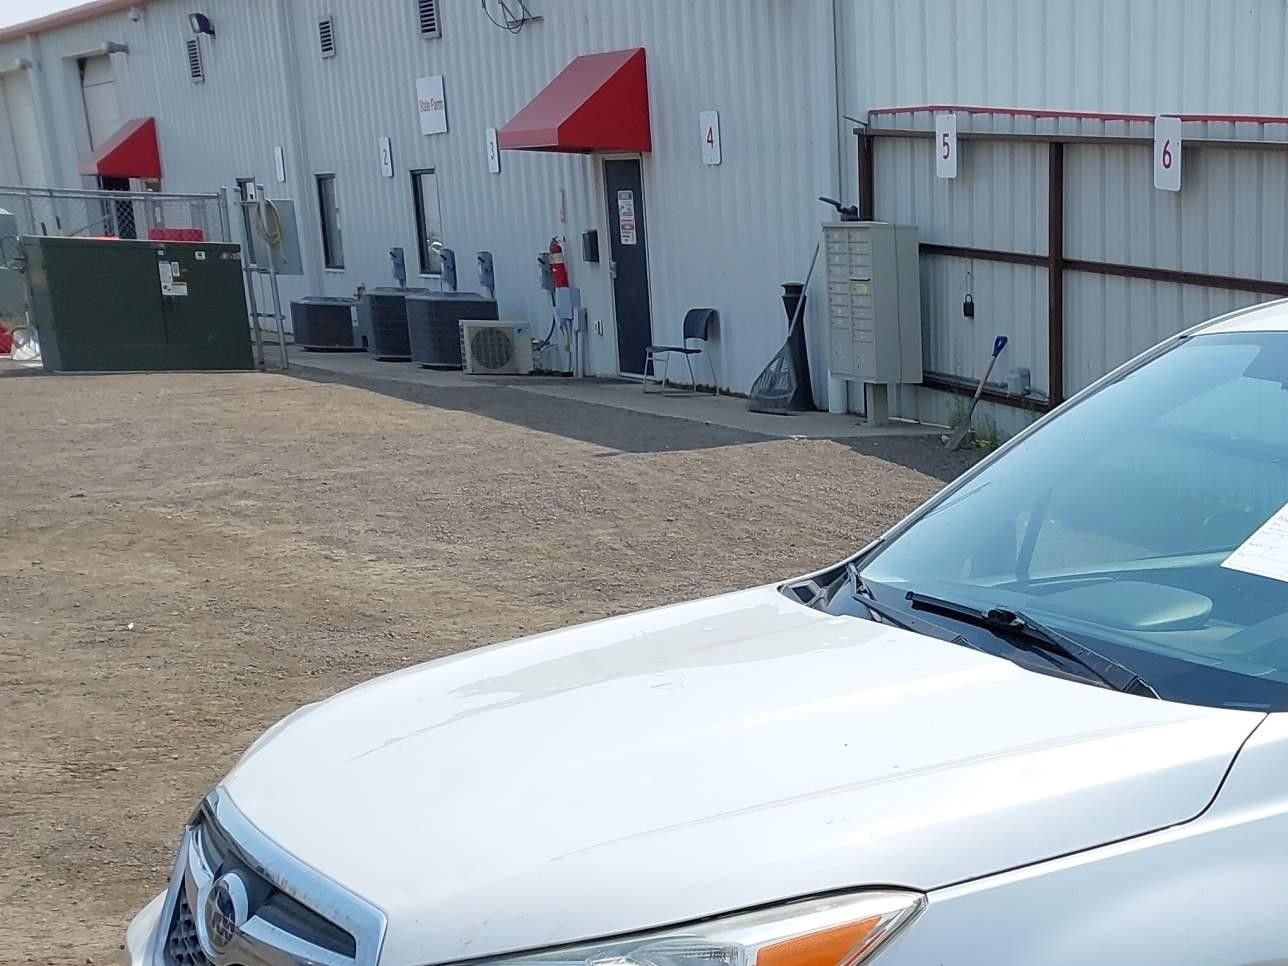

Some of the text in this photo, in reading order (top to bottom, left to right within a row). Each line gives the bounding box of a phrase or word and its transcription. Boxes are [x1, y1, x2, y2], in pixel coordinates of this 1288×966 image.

[706, 126, 714, 149] 4
[942, 133, 950, 160] 5
[1162, 139, 1172, 169] 6
